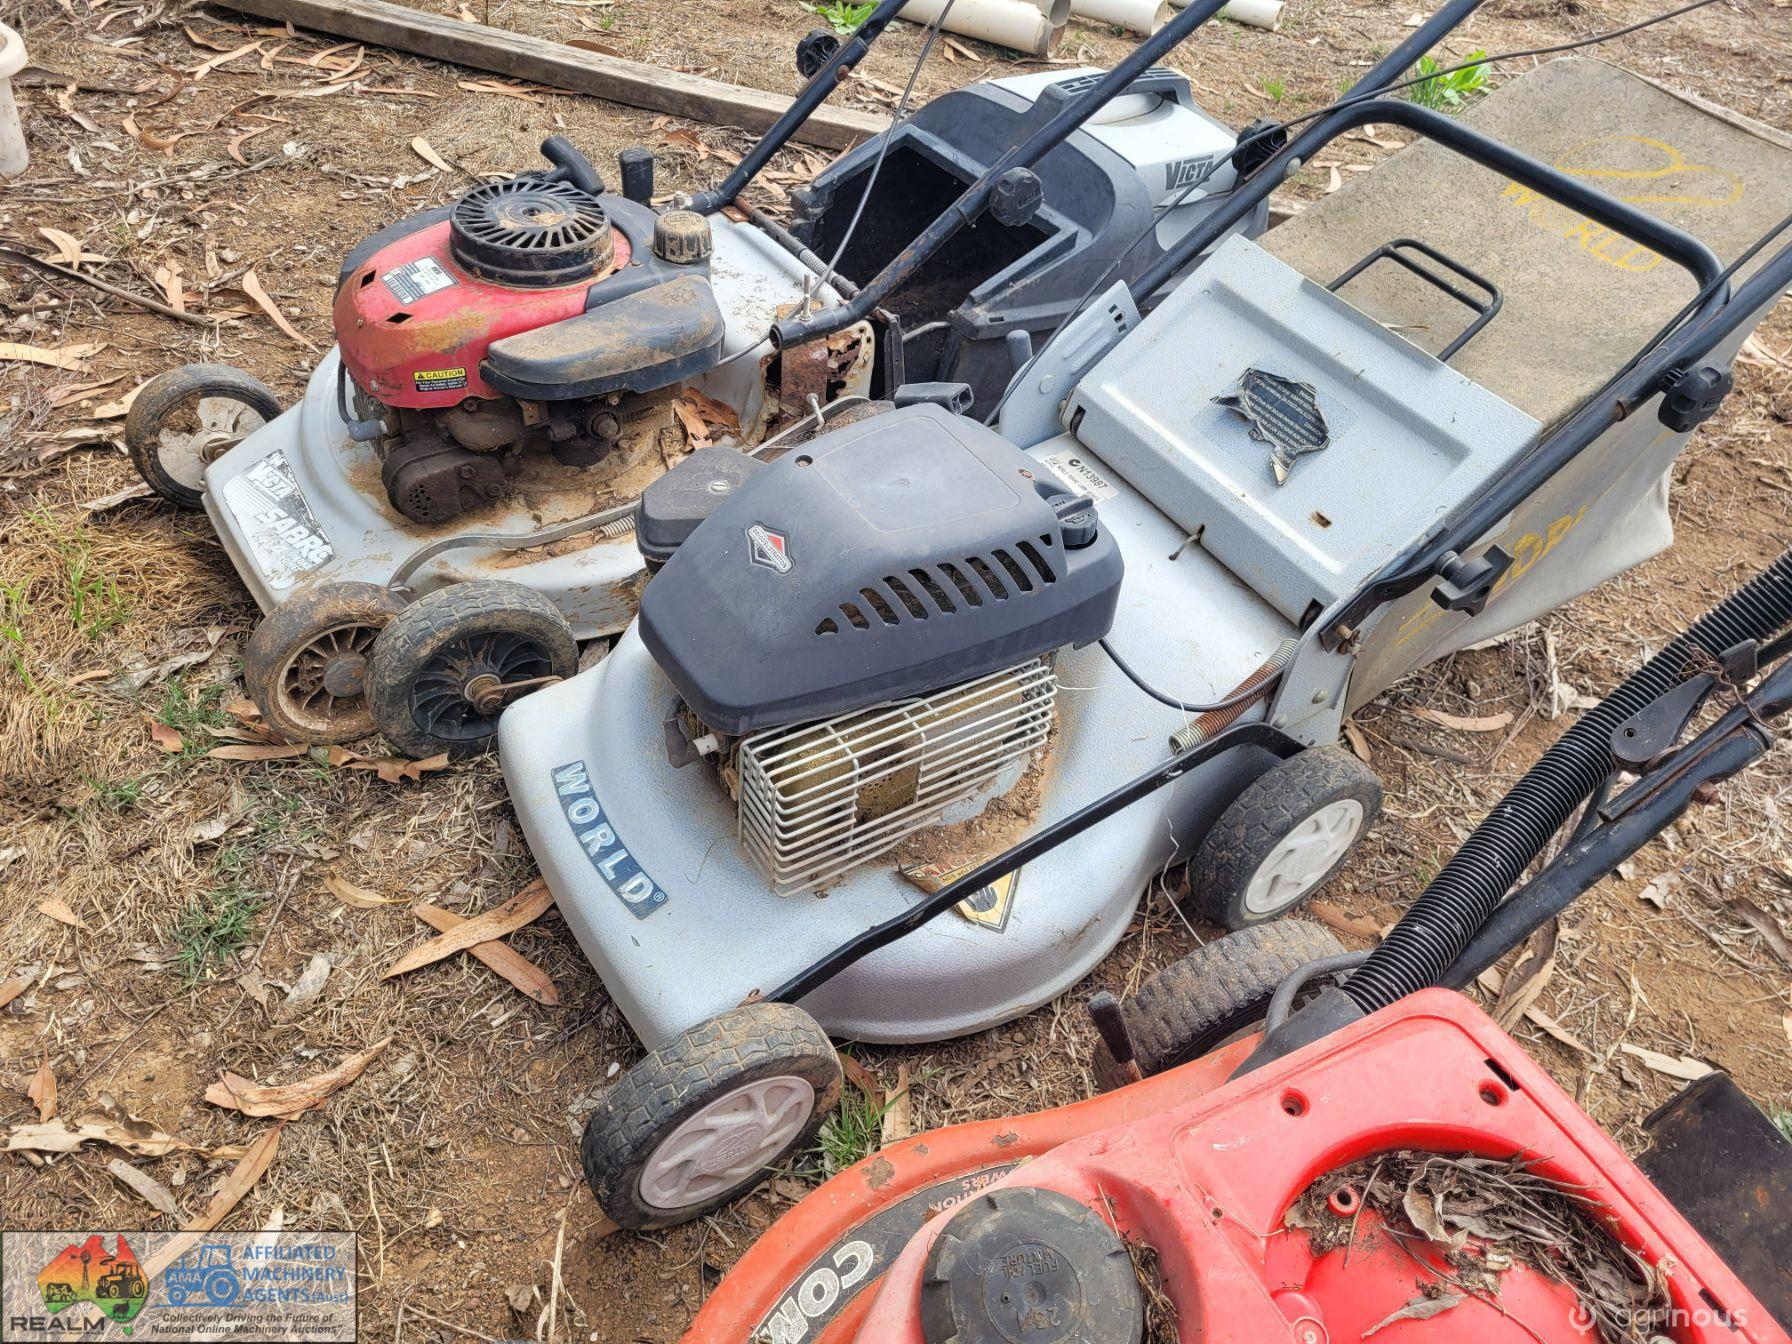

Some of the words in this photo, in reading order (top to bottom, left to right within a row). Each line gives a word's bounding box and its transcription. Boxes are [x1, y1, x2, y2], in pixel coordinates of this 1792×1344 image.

[426, 370, 463, 379] CAUTION
[1077, 465, 1108, 489] N13987
[753, 528, 769, 546] BRIGGS
[769, 547, 787, 569] STRATTON
